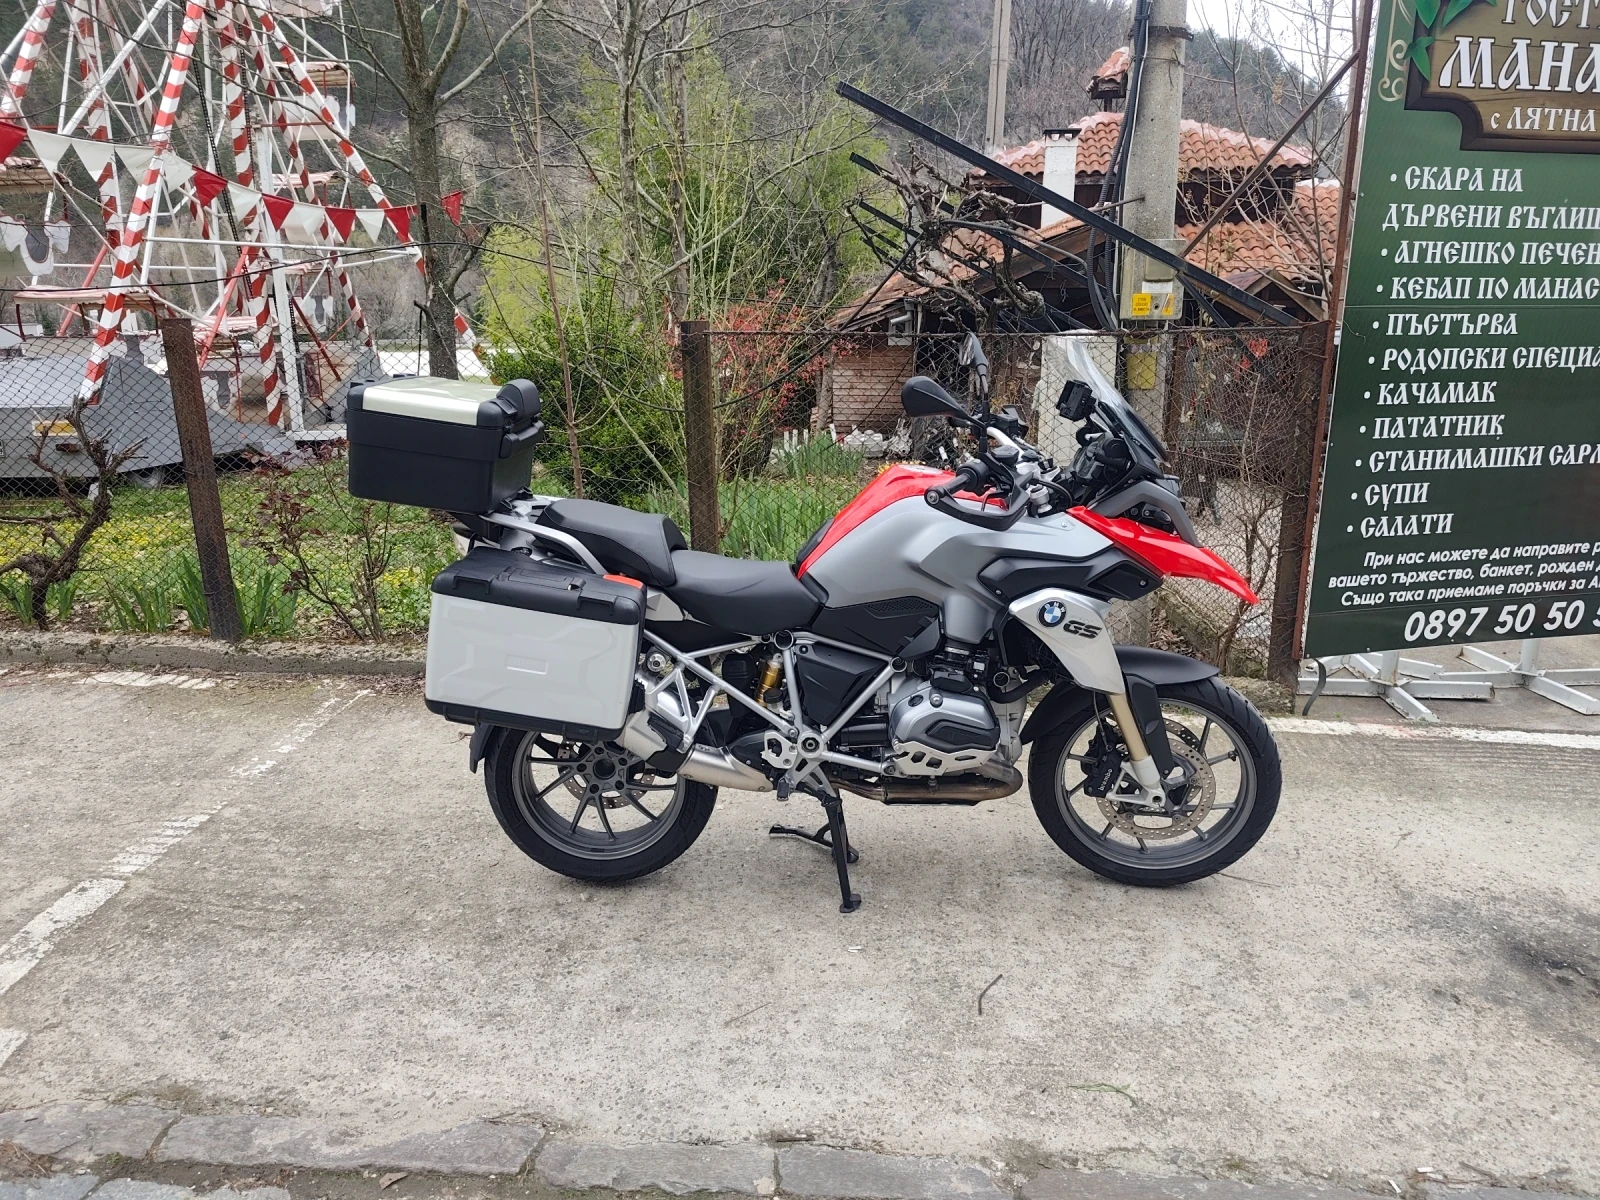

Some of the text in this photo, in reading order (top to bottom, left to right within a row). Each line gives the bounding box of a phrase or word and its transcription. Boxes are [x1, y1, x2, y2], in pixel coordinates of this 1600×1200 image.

[1502, 0, 1600, 28] ГОСТ
[1439, 35, 1600, 93] МАНА
[1506, 106, 1597, 132] ЛЯТНА
[1404, 165, 1524, 192] СКАРА НА
[1381, 203, 1504, 231] ДЪРВЕНИ
[1394, 240, 1600, 265] АГНЕШКО ПЕЧЕН
[1389, 276, 1600, 300] КЕБАП ПО МАНАС
[1385, 312, 1519, 335] ПЪСТЪРВА
[1381, 347, 1509, 375] РОДОПСКИ
[1376, 381, 1498, 406] КАЧАМАК
[1372, 414, 1506, 439] ПАТАТНИК
[1368, 445, 1545, 473] СТАНИМАШКИ
[1364, 482, 1431, 512] СУПИ
[1360, 513, 1455, 538] САЛАТИ
[1363, 551, 1394, 569] При
[1396, 551, 1425, 565] нас
[1427, 548, 1488, 563] можете
[1489, 546, 1511, 560] да
[1512, 542, 1591, 560] направите
[1328, 574, 1388, 588] вашето
[1391, 568, 1474, 586] тържество,
[1479, 563, 1534, 578] банкет,
[1536, 560, 1595, 577] рожден
[1341, 575, 1600, 606] Също така приемаме поръчки за А
[1063, 620, 1103, 639] GS
[1404, 607, 1489, 641] 0897
[1493, 603, 1536, 634] 50
[1543, 599, 1585, 631] 50
[1097, 768, 1113, 791] brembo
